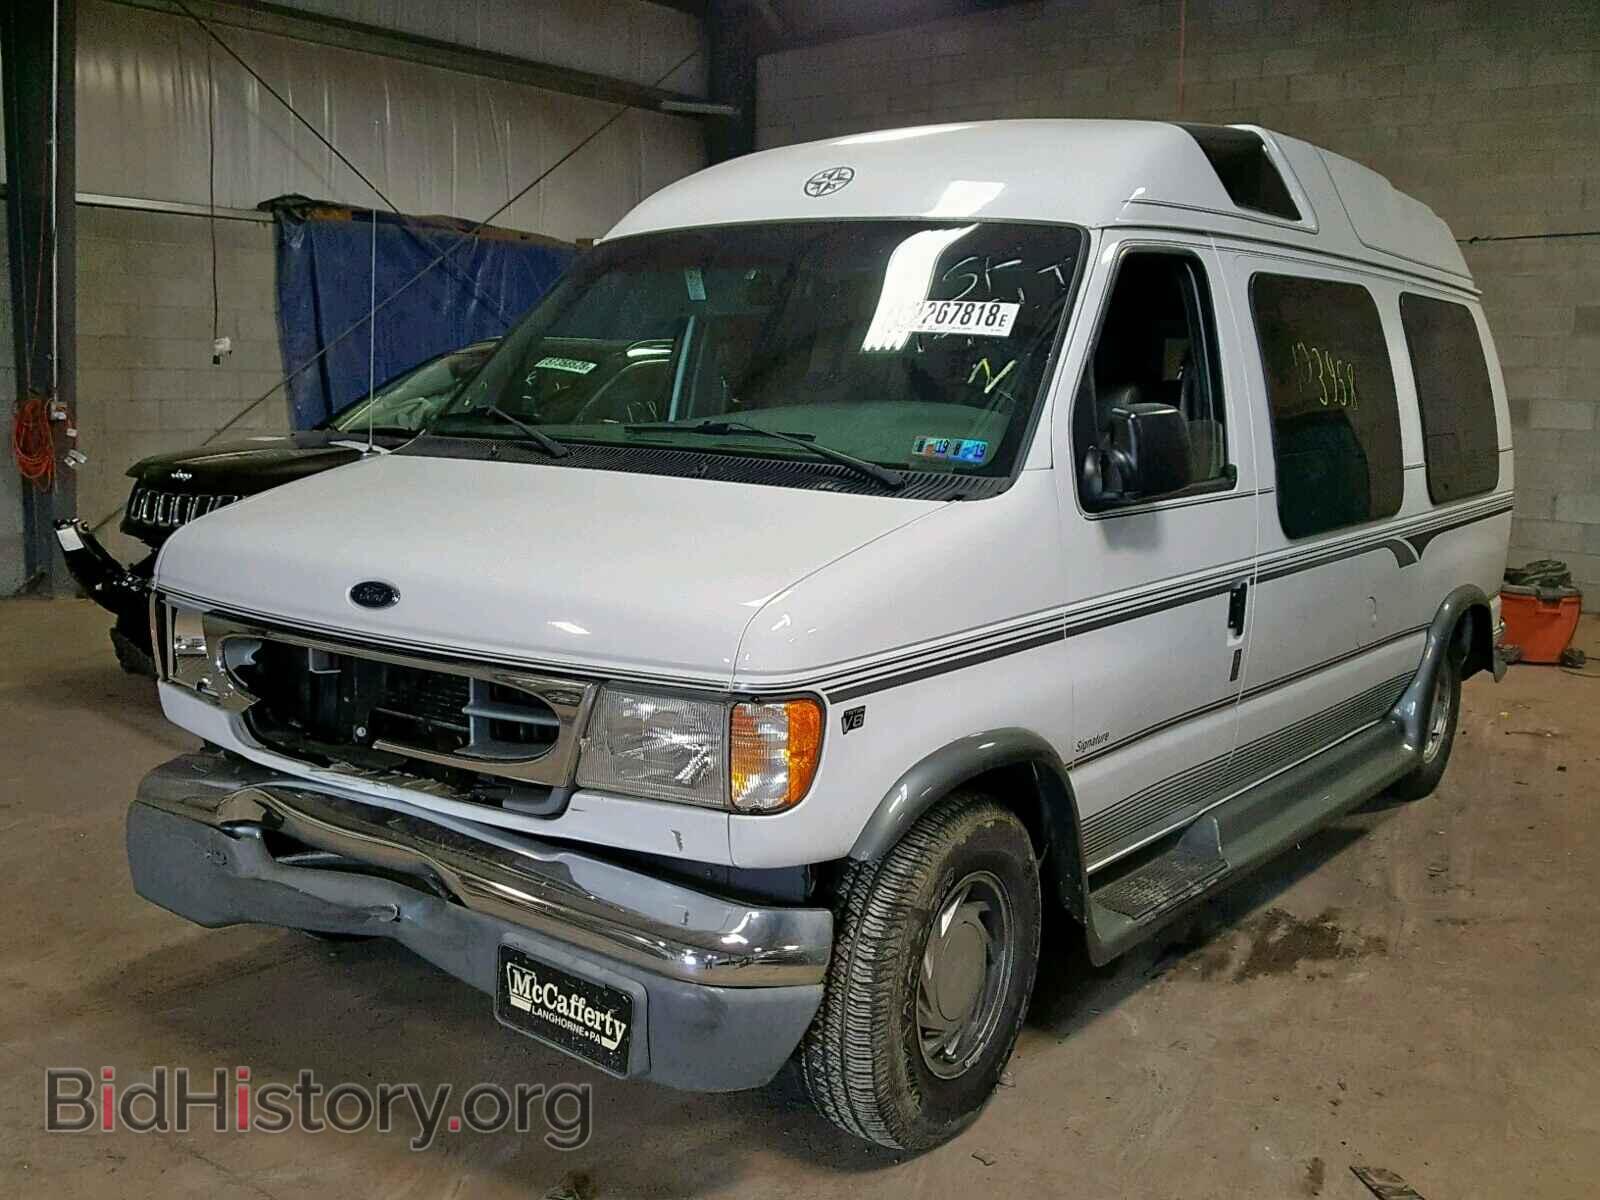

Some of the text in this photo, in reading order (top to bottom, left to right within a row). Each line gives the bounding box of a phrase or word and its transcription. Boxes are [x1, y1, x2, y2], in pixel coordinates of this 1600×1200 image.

[842, 714, 863, 732] V8
[1075, 731, 1109, 752] Signature
[511, 969, 626, 1048] McCafferty
